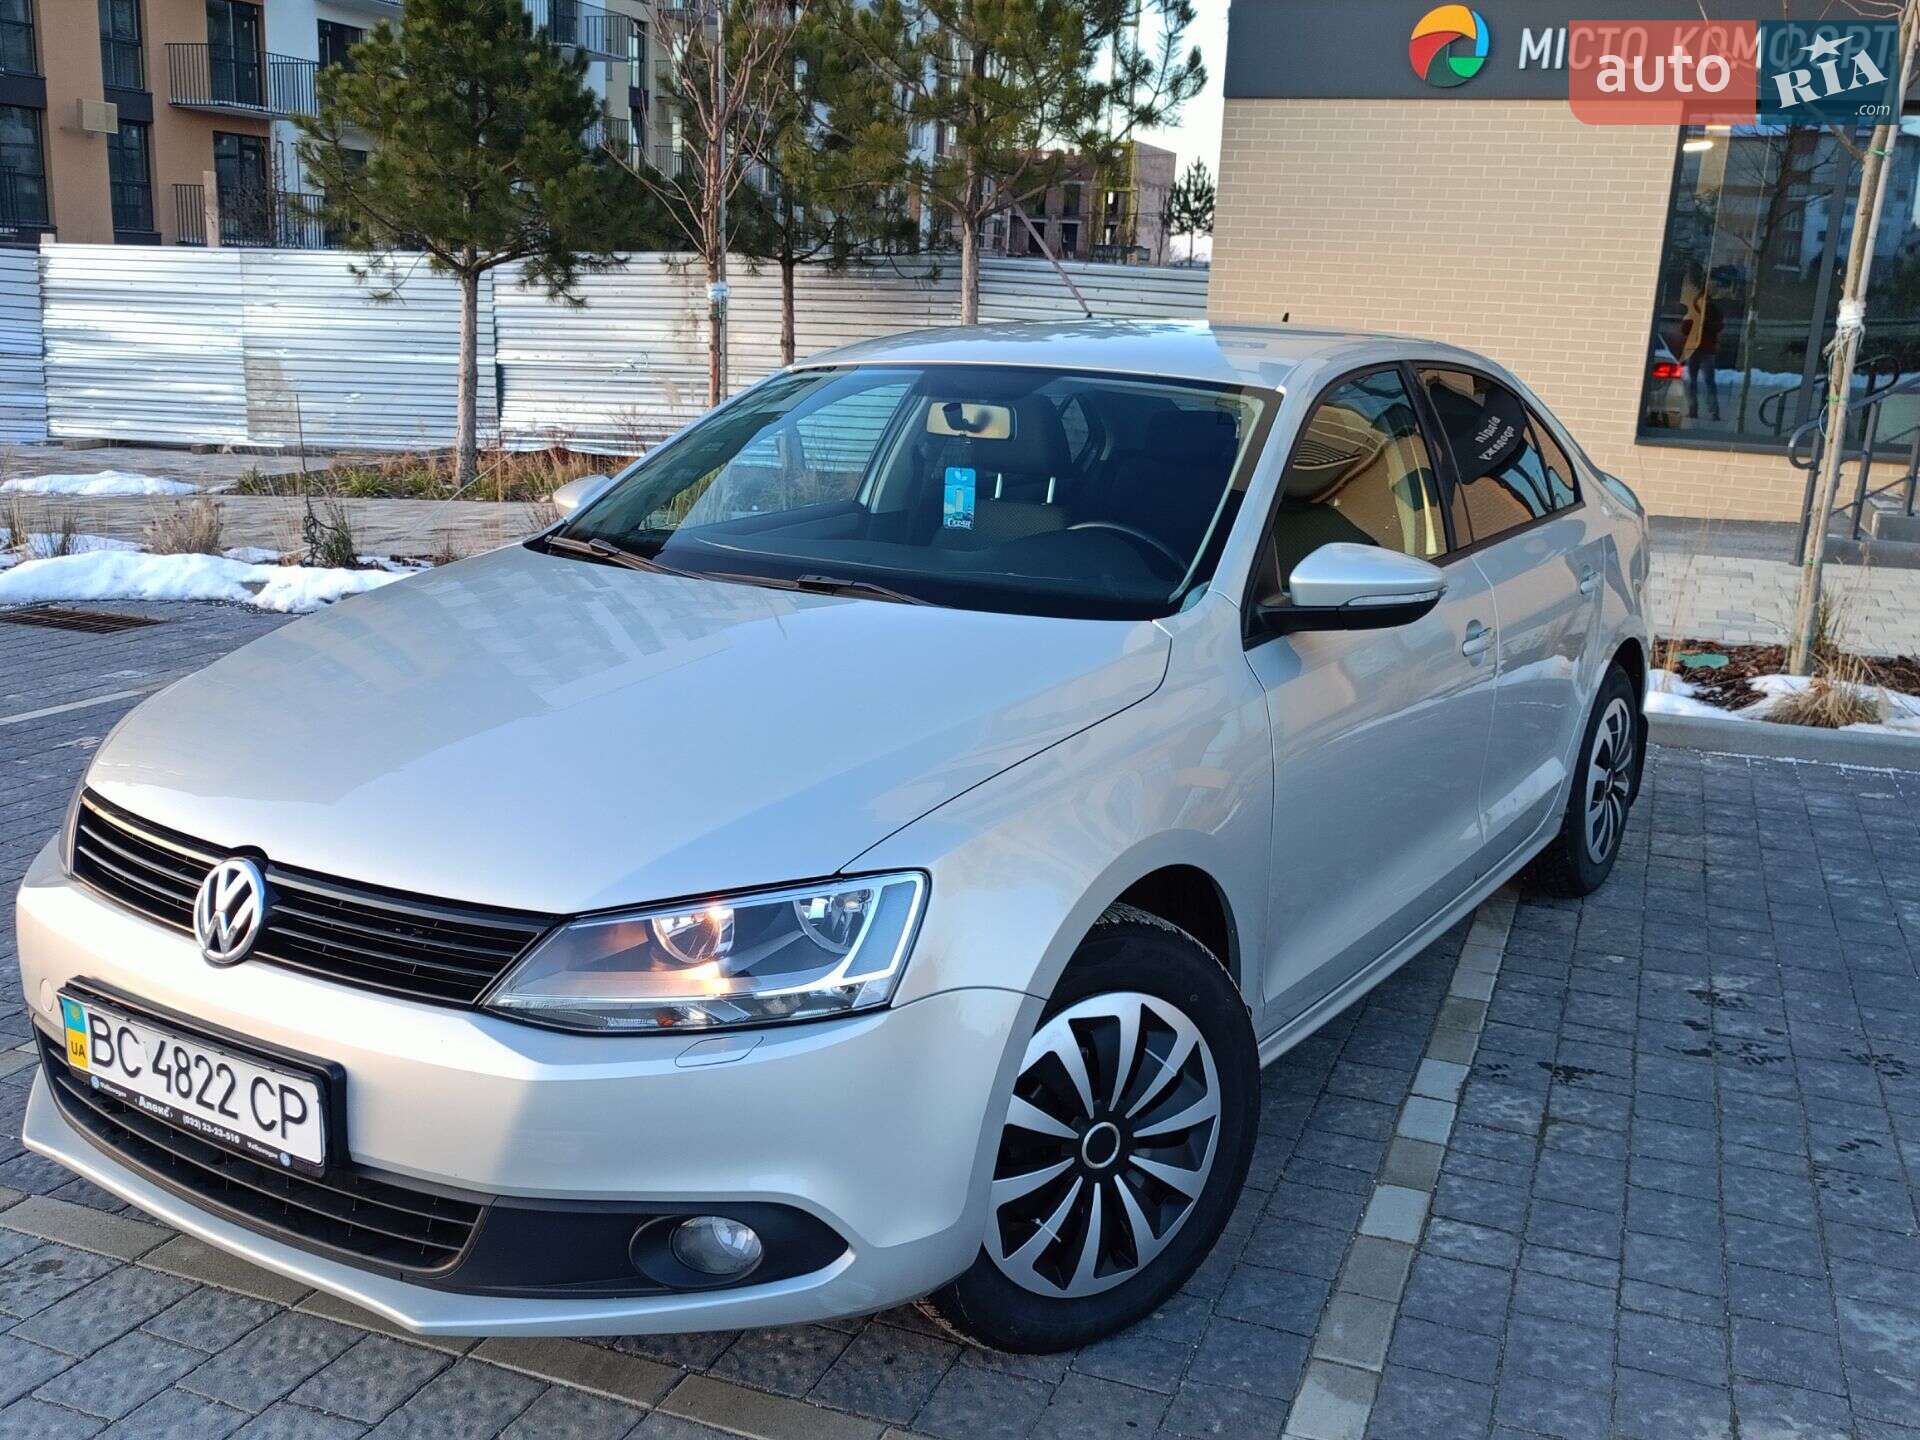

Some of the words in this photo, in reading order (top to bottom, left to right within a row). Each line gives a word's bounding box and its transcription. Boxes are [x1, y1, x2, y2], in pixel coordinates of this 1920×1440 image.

[70, 1041, 87, 1059] UA
[89, 1013, 142, 1078] BC
[152, 1040, 239, 1120] 4822
[250, 1076, 307, 1139] CP
